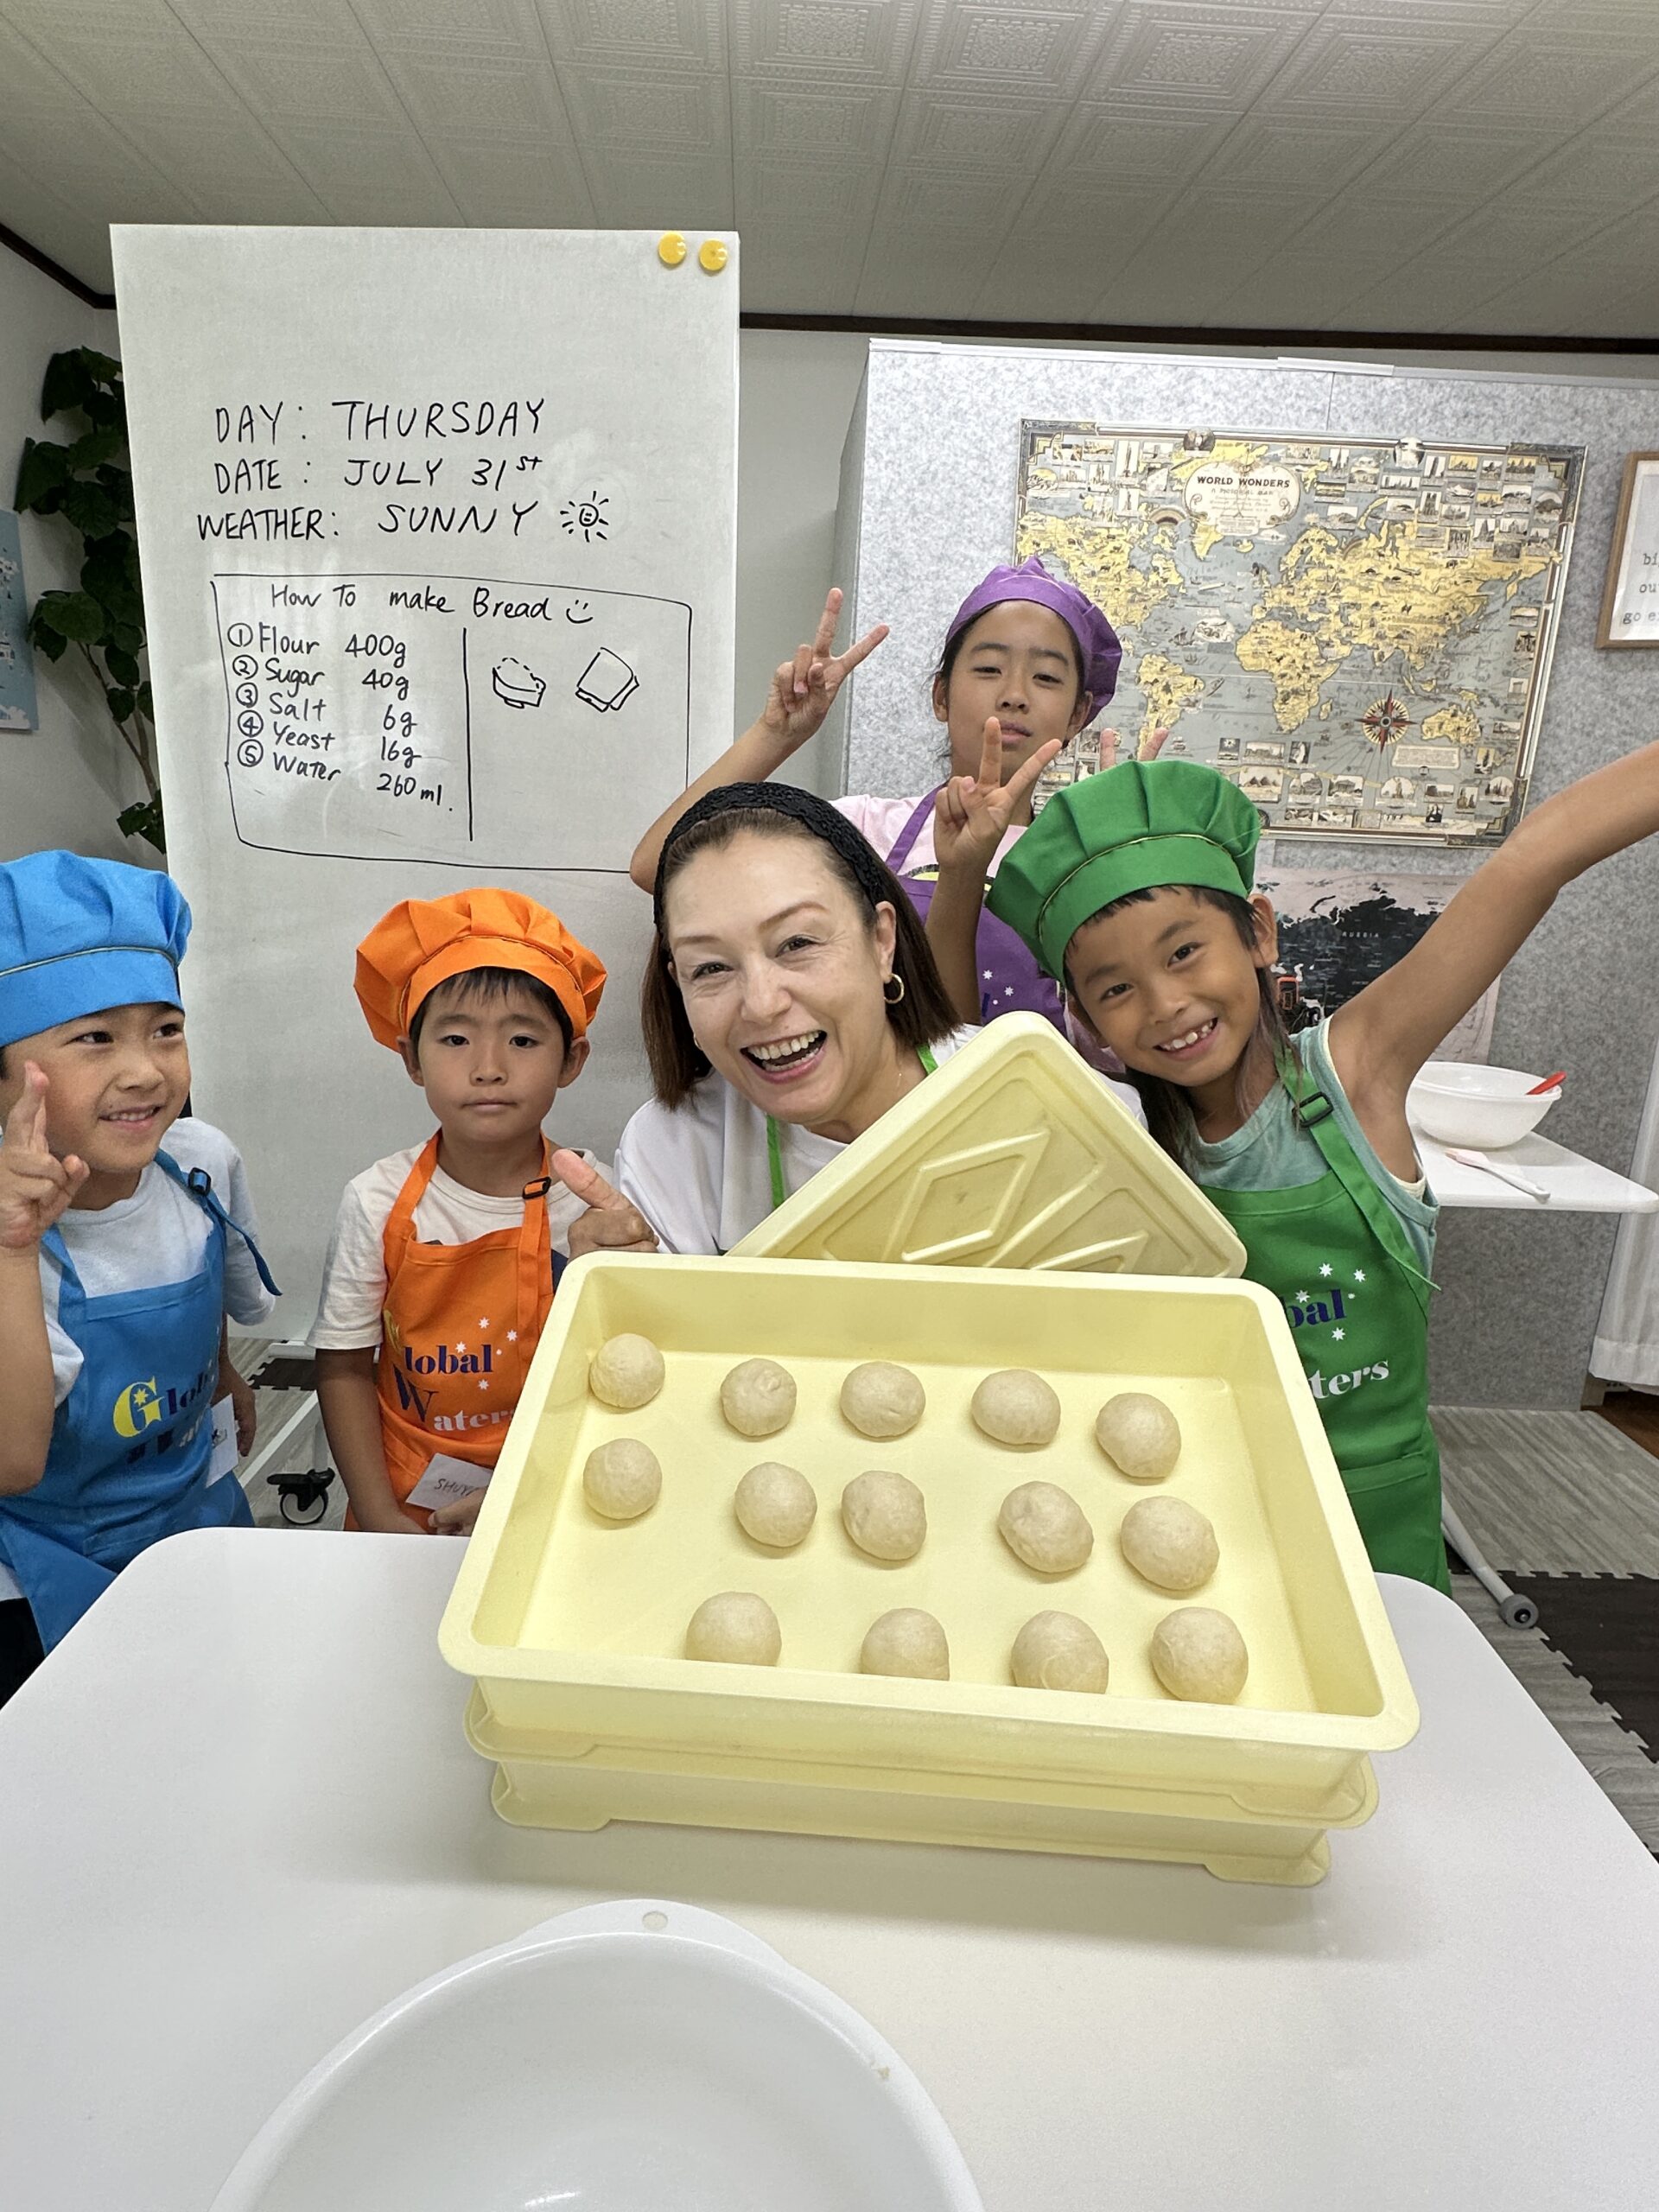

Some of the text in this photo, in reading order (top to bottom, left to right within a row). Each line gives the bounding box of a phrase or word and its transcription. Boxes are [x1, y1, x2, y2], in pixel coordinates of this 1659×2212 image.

[332, 398, 544, 441] THURSDAY
[344, 458, 442, 486] JULY
[1197, 476, 1290, 488] WORLD WONDERS
[197, 500, 539, 541] WEATHER: SUNNY
[271, 583, 552, 621] How To make Bread
[1623, 611, 1642, 625] go
[258, 621, 321, 655] Flour
[345, 633, 407, 669] 400g
[264, 657, 326, 697] Sugar
[361, 668, 410, 701] 40g
[269, 692, 327, 722] Salt
[383, 704, 417, 736] 6g
[273, 720, 336, 752] Yeast
[379, 736, 423, 769] 16g
[273, 751, 342, 782] Water
